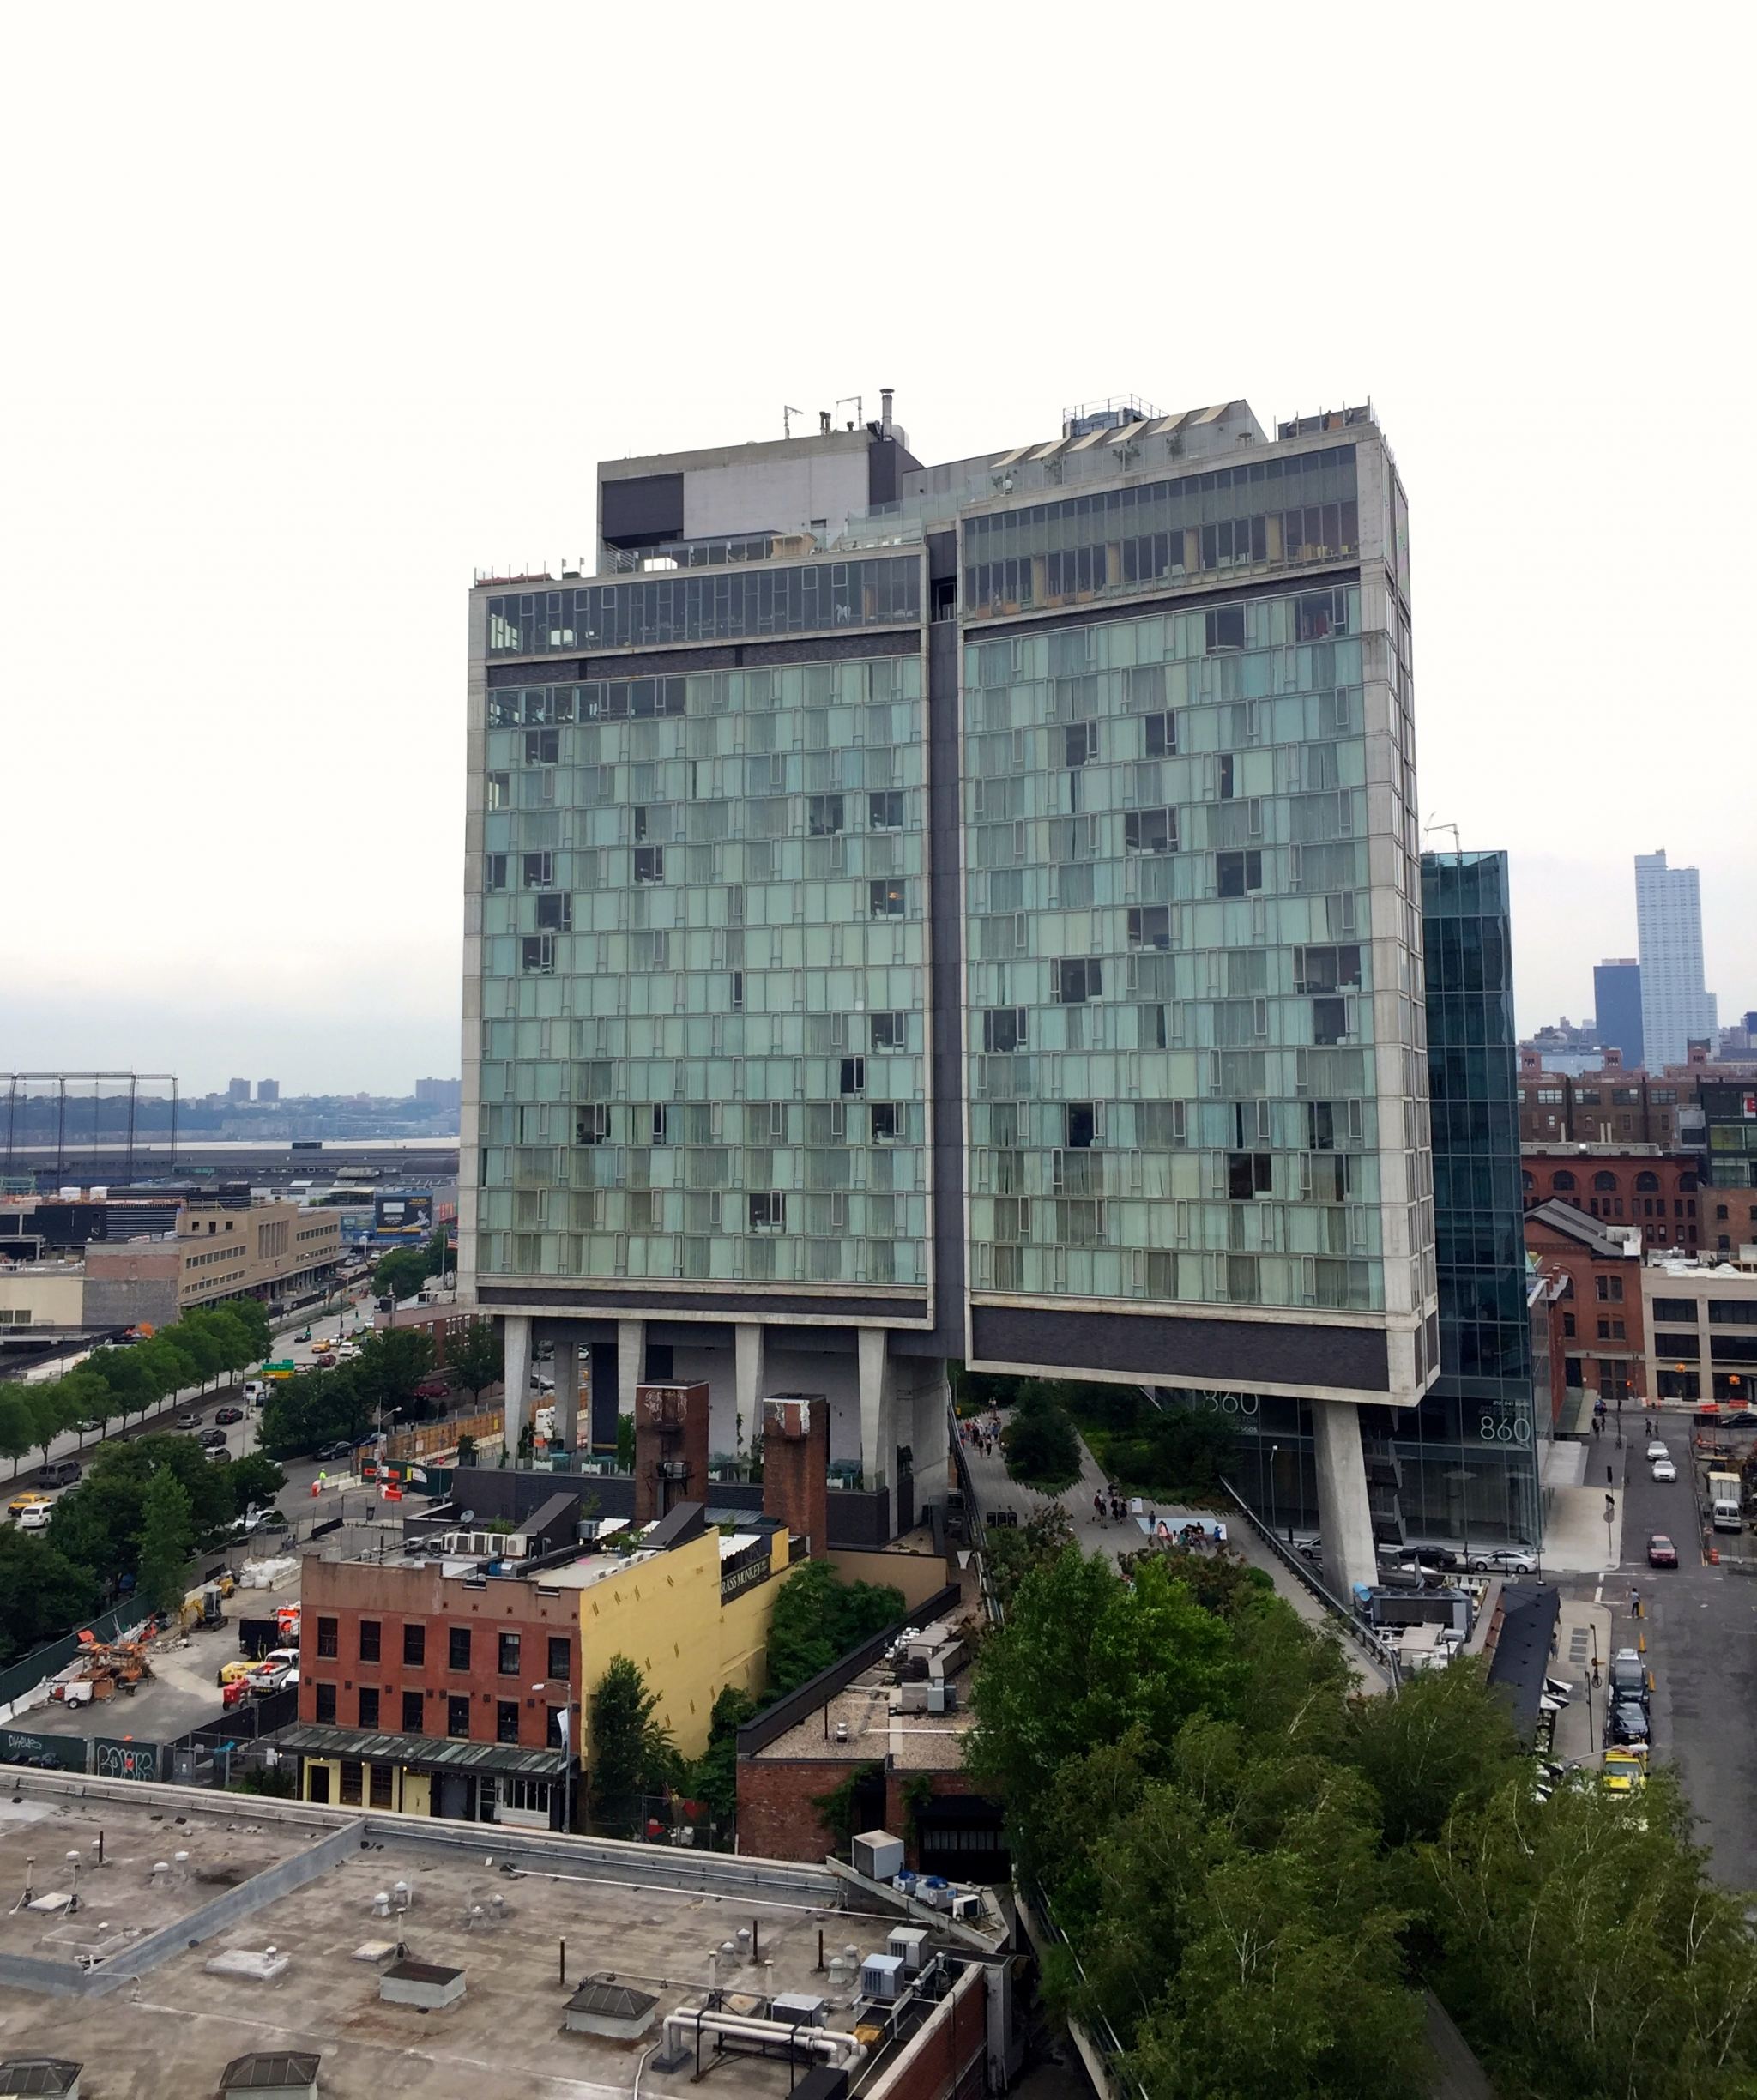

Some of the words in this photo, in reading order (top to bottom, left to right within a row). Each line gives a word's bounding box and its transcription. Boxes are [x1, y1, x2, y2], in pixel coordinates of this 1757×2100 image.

[1480, 1415, 1531, 1442] 860
[721, 1575, 737, 1596] RASS
[736, 1562, 761, 1587] MONKEY
